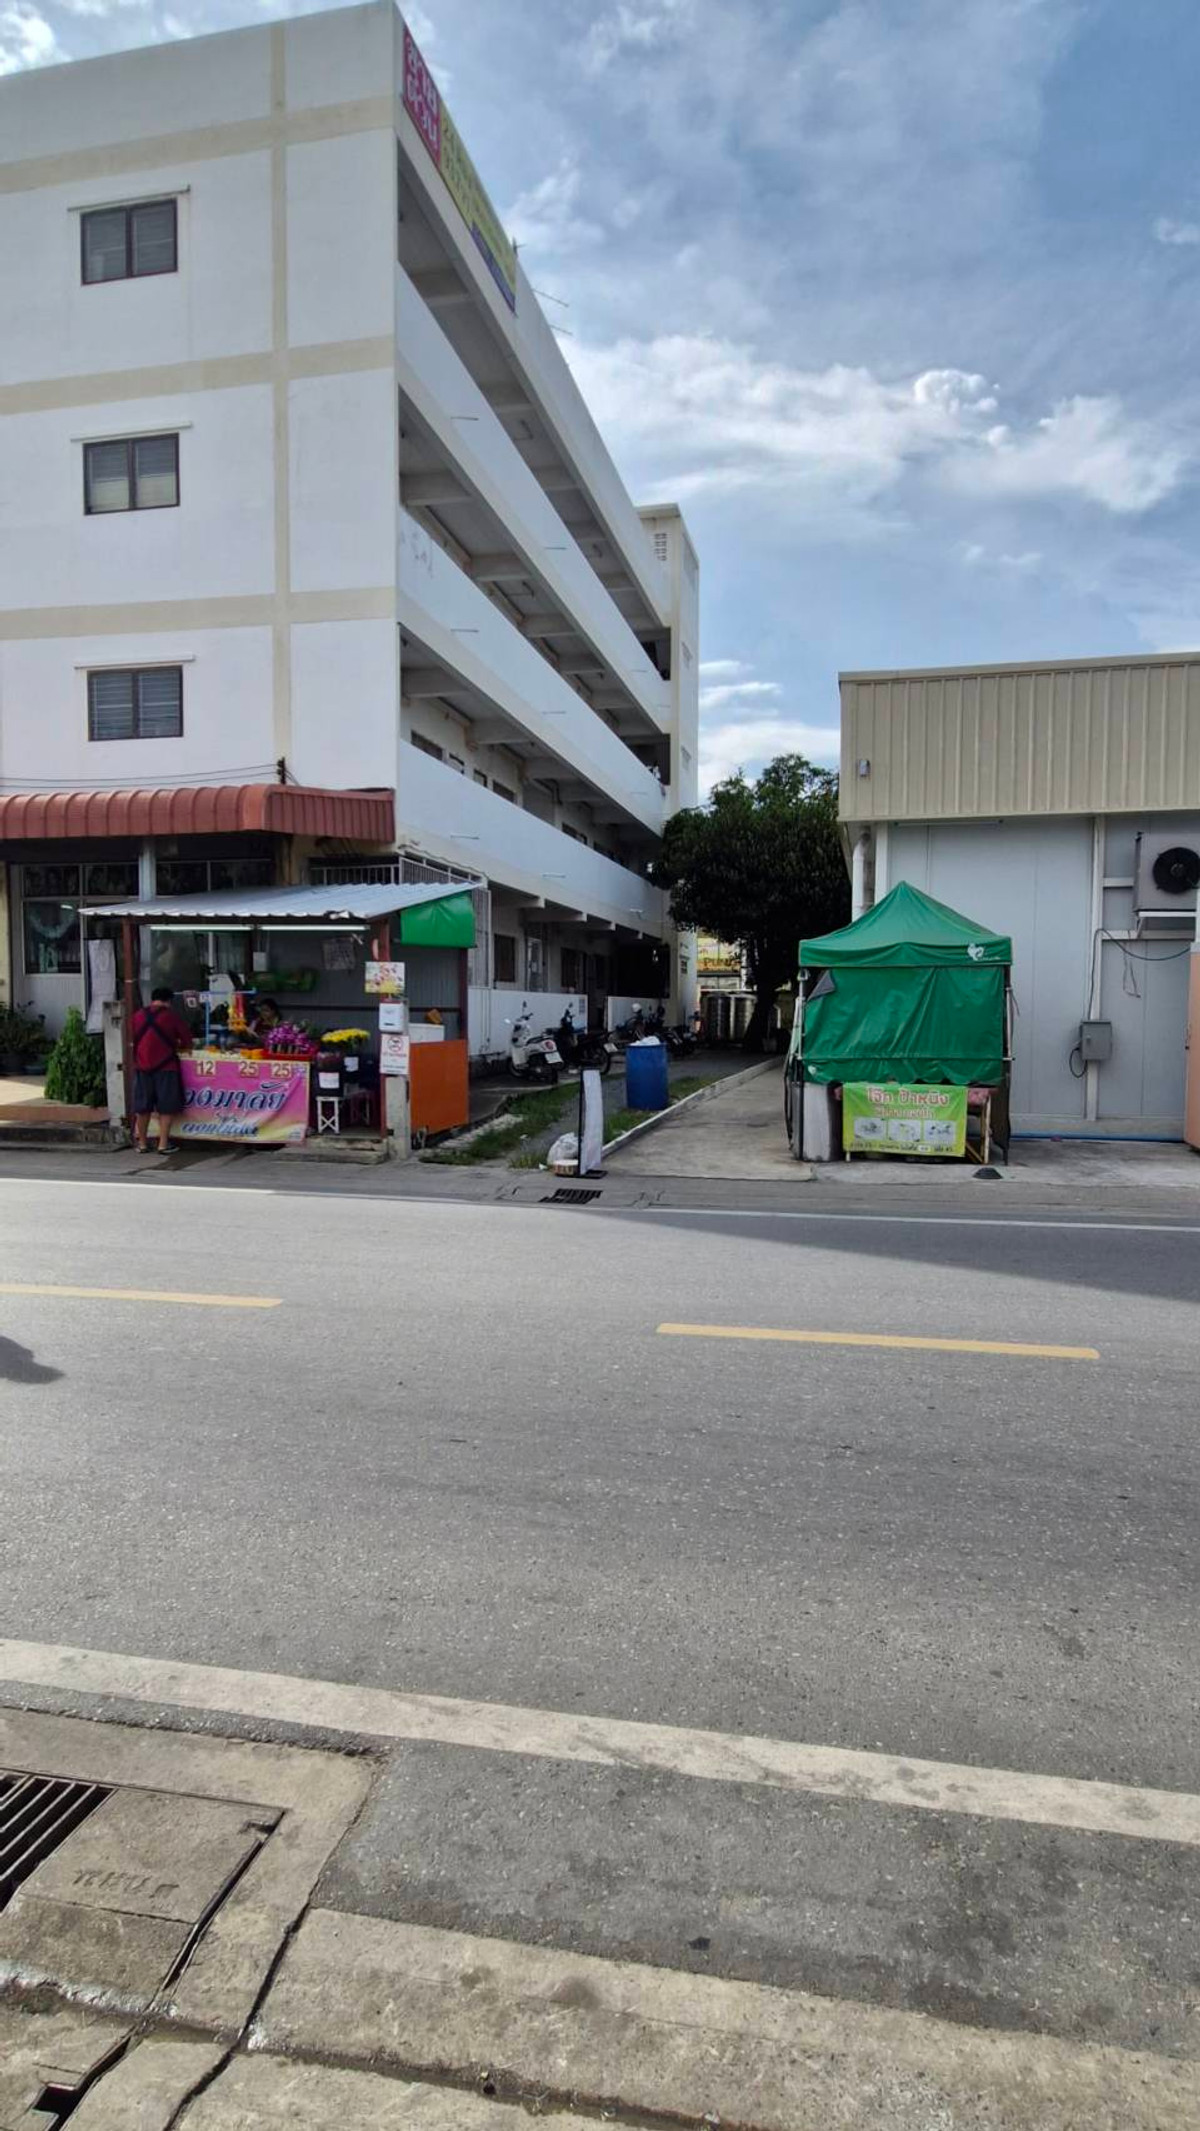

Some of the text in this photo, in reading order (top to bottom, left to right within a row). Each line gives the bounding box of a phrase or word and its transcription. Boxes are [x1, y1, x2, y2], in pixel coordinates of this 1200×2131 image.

[197, 1060, 214, 1075] 12
[239, 1061, 257, 1076] 25
[273, 1062, 290, 1077] 25
[182, 1082, 290, 1111] วงมาลัย
